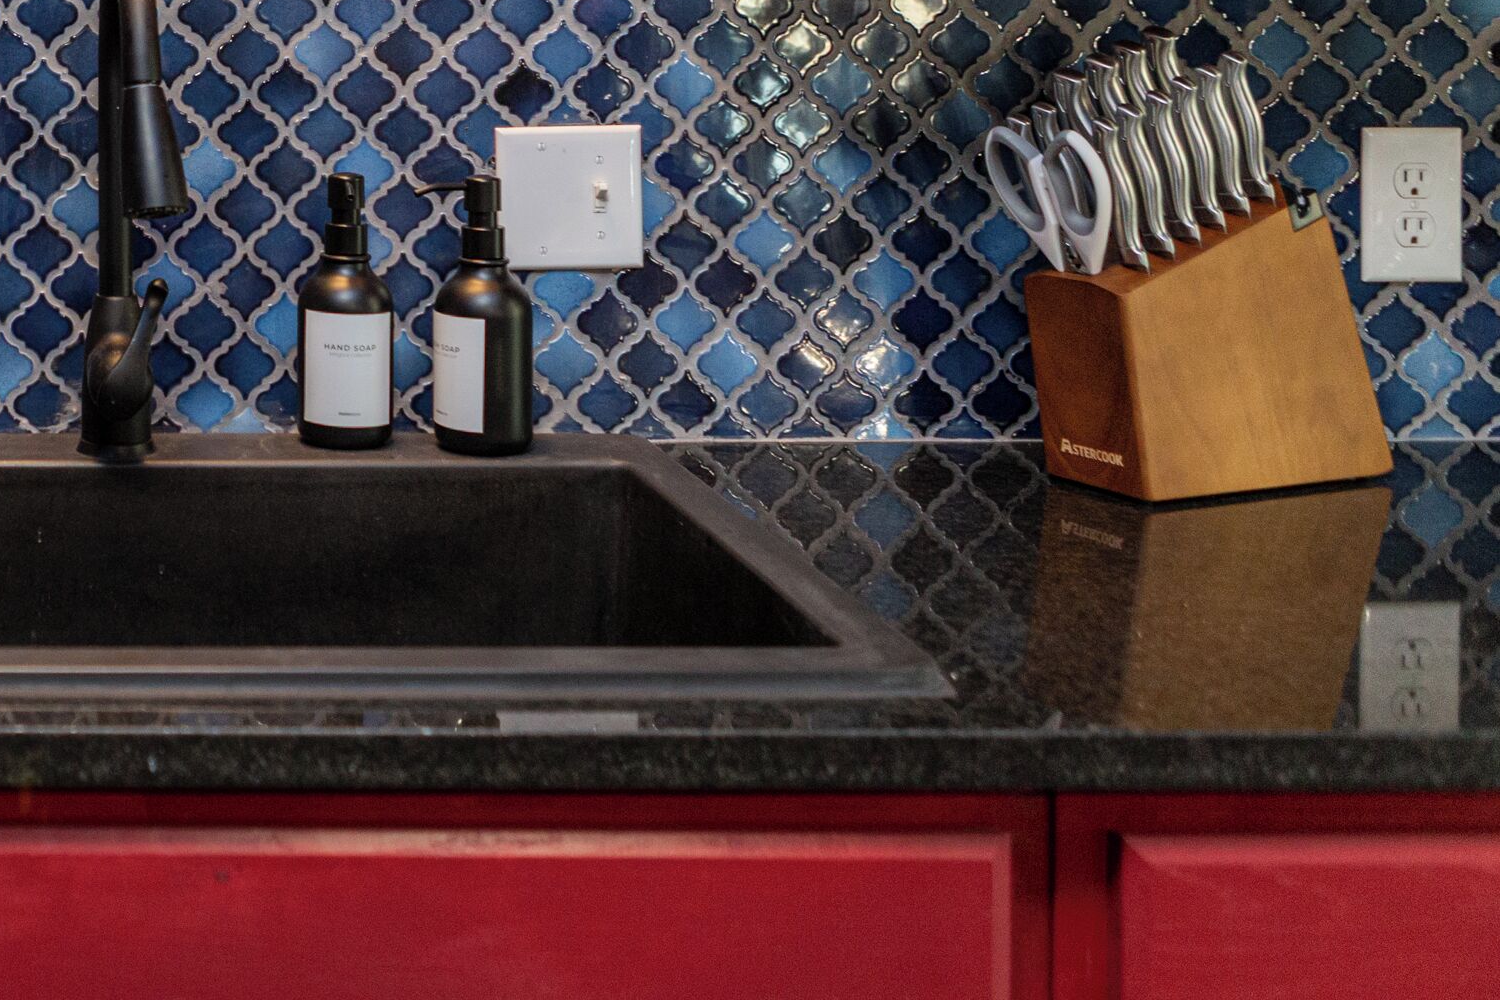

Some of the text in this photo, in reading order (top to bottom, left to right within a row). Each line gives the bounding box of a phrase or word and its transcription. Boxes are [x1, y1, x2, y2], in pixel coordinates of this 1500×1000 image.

[323, 343, 377, 352] HAND SOAP
[1060, 438, 1125, 467] ASTERCOOK
